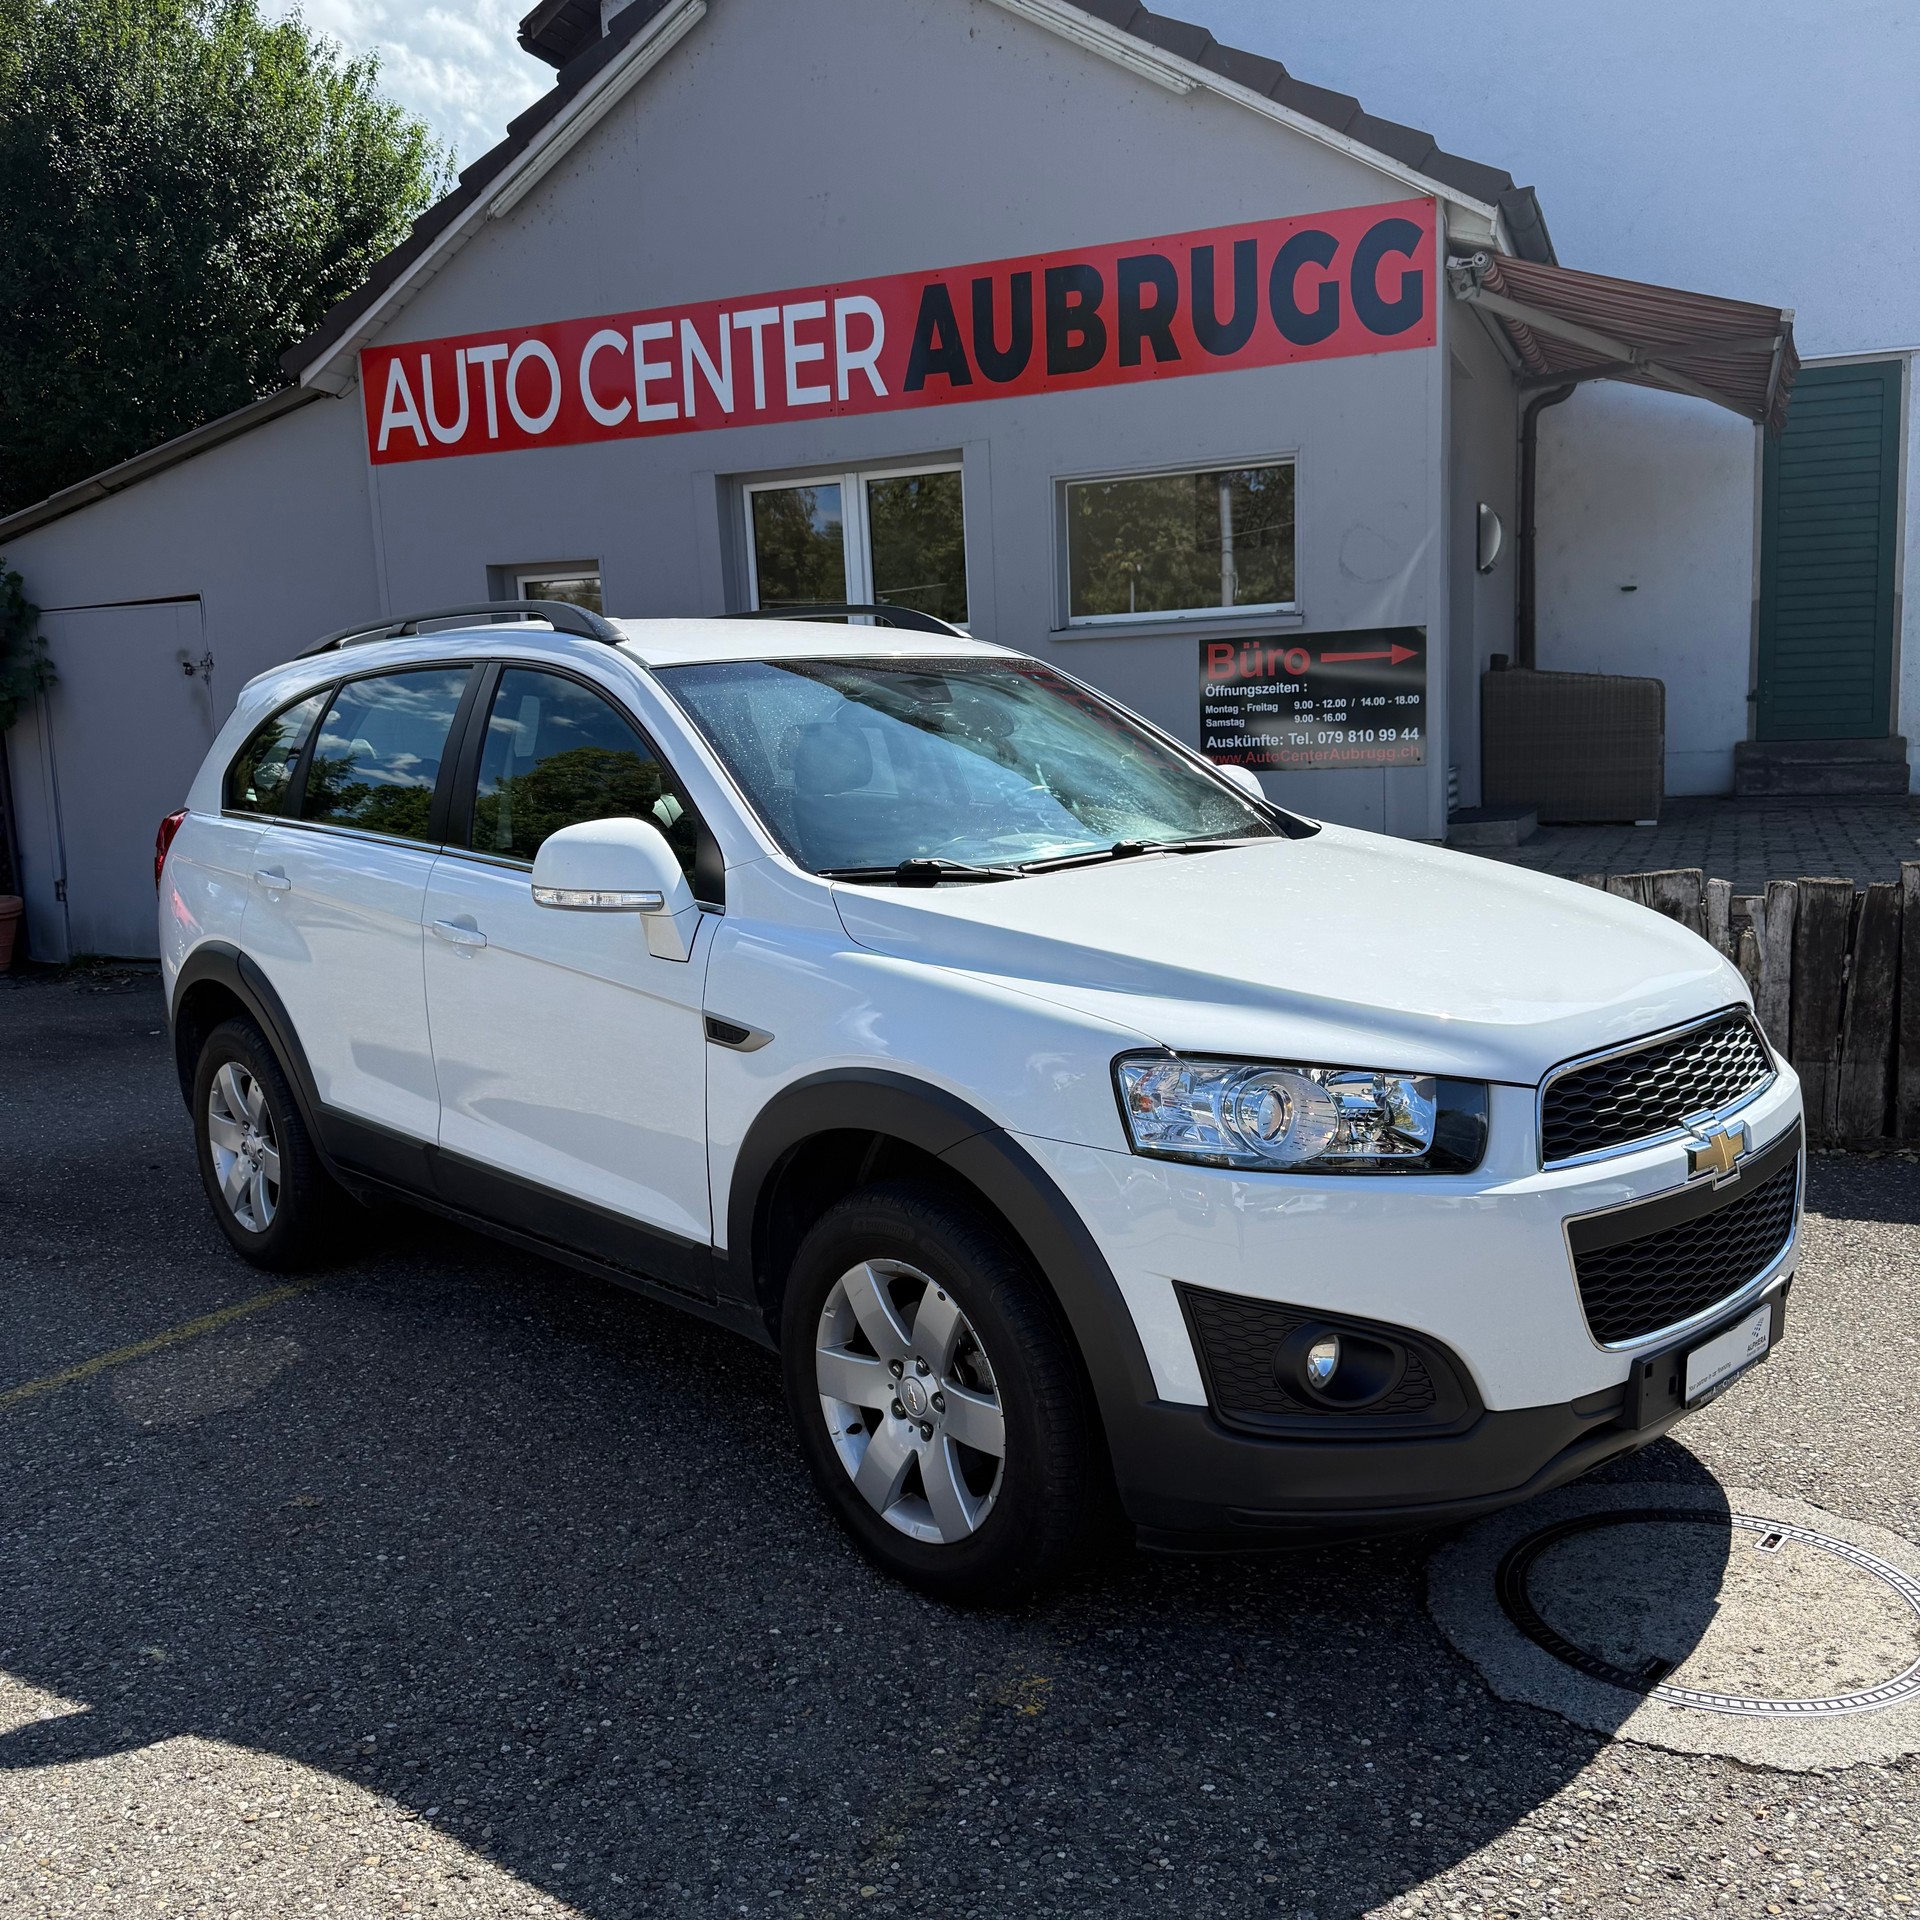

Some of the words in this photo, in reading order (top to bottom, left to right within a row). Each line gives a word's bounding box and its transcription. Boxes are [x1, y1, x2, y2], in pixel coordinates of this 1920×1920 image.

[376, 339, 562, 452] AUTO
[579, 295, 889, 427] CENTER
[902, 218, 1424, 393] AUBRUGG
[1207, 642, 1311, 680] Büro
[1205, 682, 1300, 698] Öffnungszeiten
[1205, 705, 1239, 715] Montag
[1246, 702, 1279, 713] Freitag
[1293, 700, 1314, 710] 9.00
[1321, 698, 1347, 709] 12.00
[1351, 697, 1356, 708] /
[1360, 696, 1386, 707] 14.00
[1394, 694, 1420, 705] 18.00
[1205, 718, 1246, 728] Samstag
[1294, 713, 1314, 723] 9.00
[1322, 712, 1347, 722] 16.00
[1206, 734, 1284, 749] Auskünfte:
[1287, 732, 1314, 746] Tel.
[1317, 730, 1344, 744] 079
[1347, 729, 1375, 743] 810
[1378, 728, 1397, 741] 99
[1400, 727, 1420, 741] 44
[1210, 745, 1420, 765] www.AutoCenterAubrugg.ch
